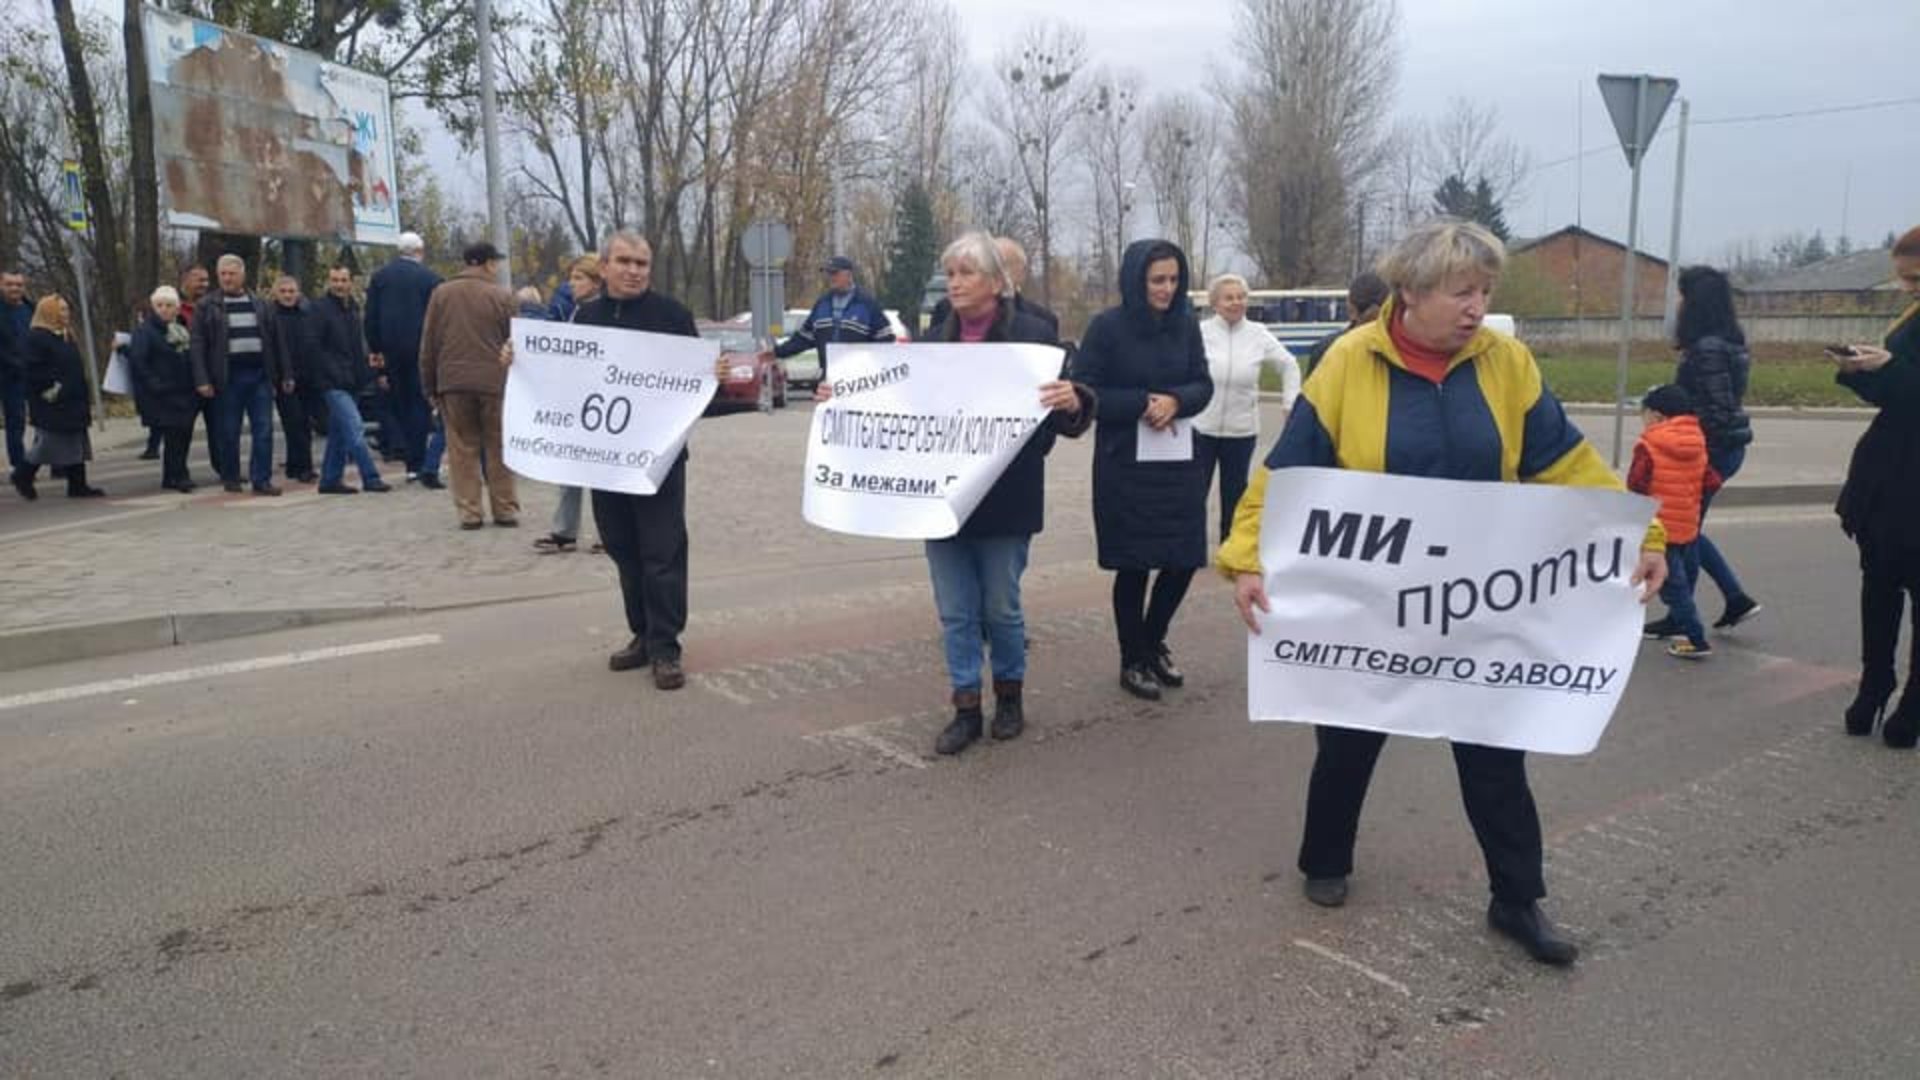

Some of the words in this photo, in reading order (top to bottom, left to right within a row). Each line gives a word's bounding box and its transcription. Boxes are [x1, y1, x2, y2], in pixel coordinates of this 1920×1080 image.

[604, 365, 702, 393] Знесіння
[833, 361, 910, 398] Будуйте
[533, 408, 575, 427] має
[581, 393, 632, 435] 60
[510, 435, 620, 462] небезпечних
[815, 464, 843, 486] За
[851, 473, 937, 495] межами
[1300, 508, 1412, 564] МИ
[1397, 537, 1623, 635] проти
[1273, 639, 1476, 679] СМІТТЄВОГО
[1484, 661, 1618, 694] ЗАВОДУ
